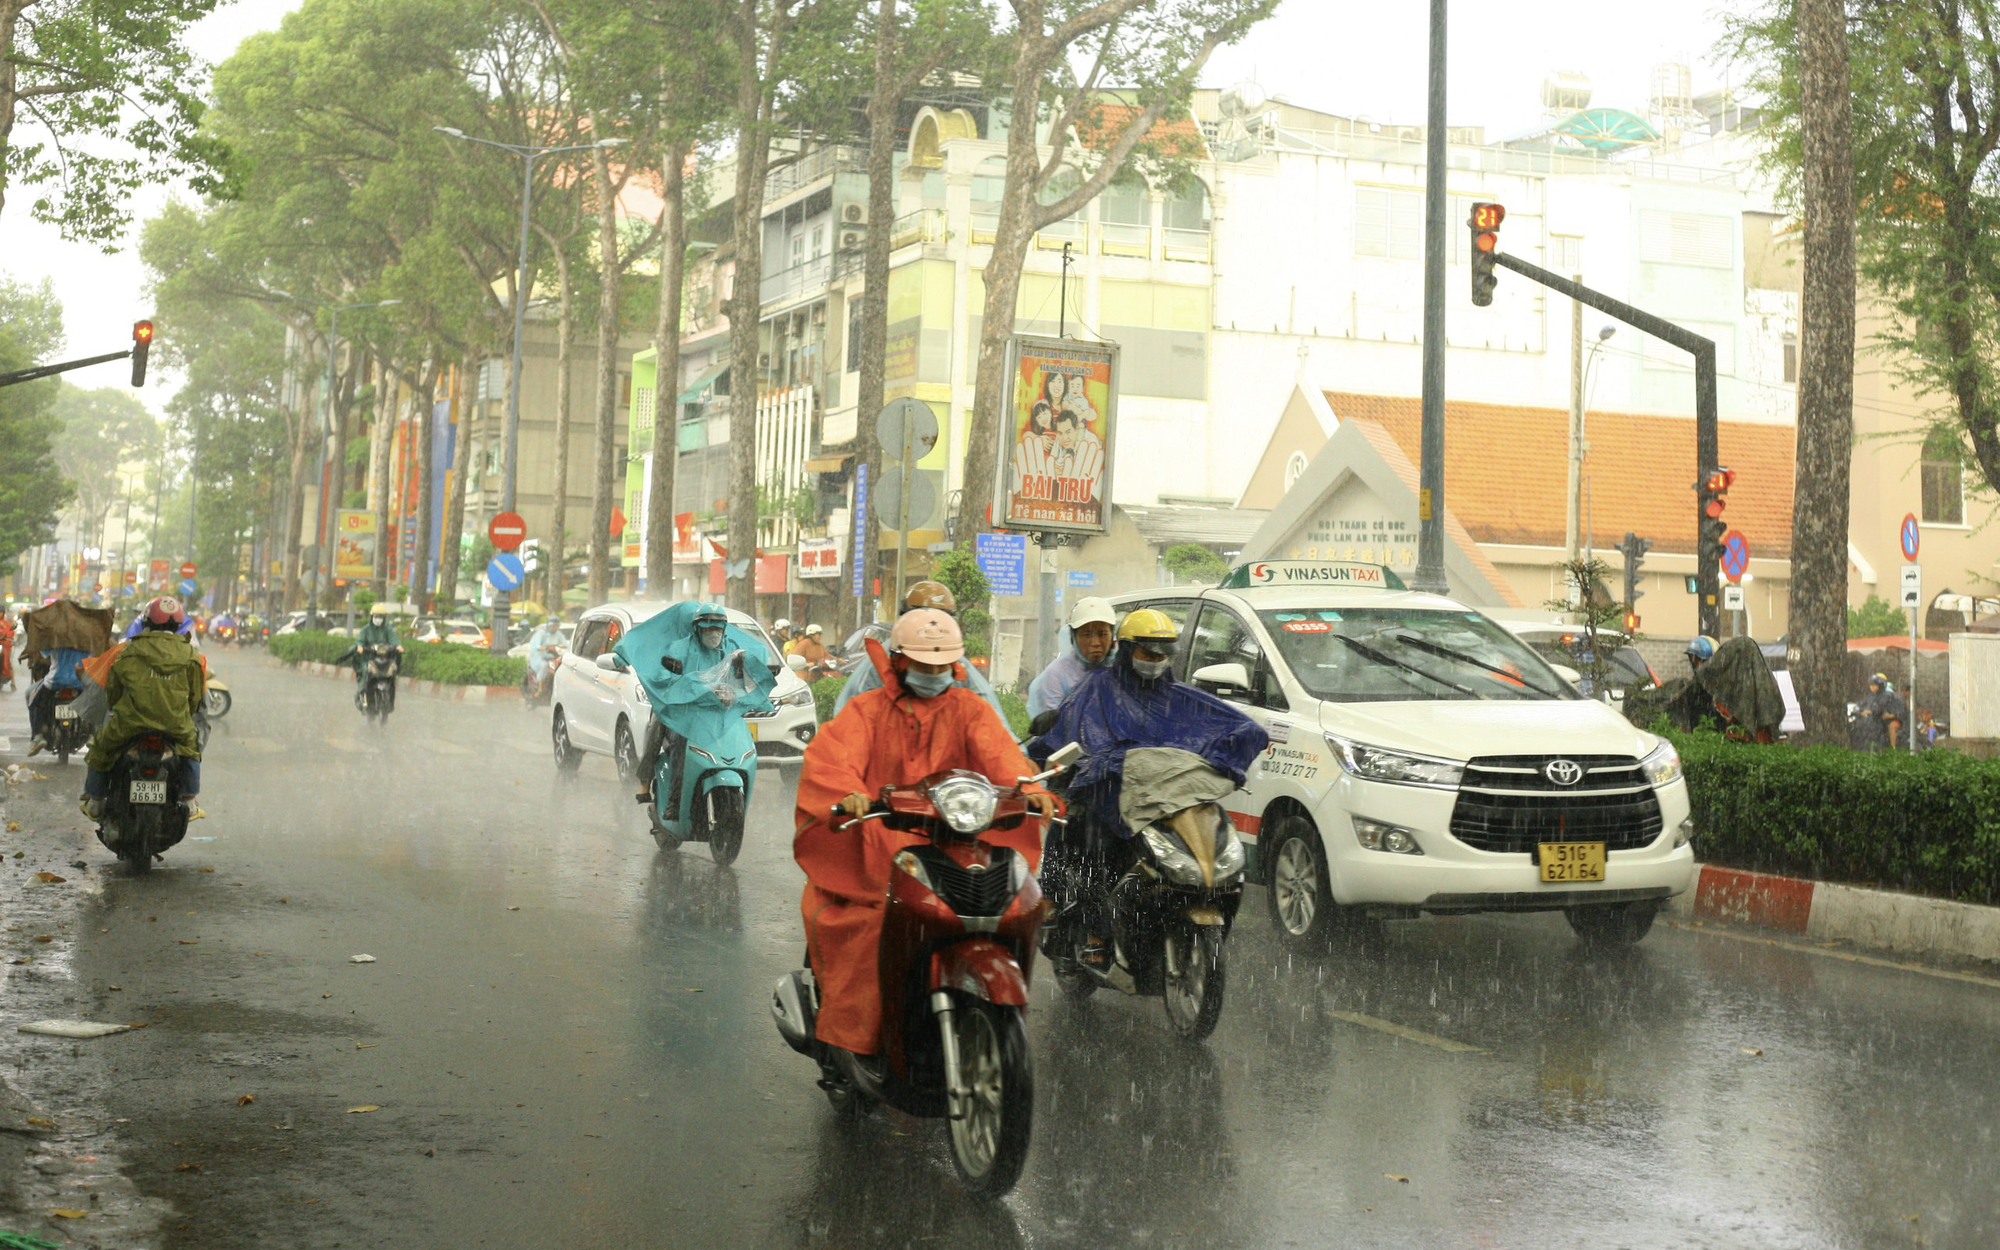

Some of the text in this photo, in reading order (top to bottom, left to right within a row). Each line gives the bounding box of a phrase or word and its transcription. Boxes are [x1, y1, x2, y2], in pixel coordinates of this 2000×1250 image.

[1478, 208, 1496, 227] 21
[1021, 470, 1094, 503] BÀI TRỪ
[1287, 622, 1328, 632] 10355
[1271, 761, 1281, 773] 38
[1282, 763, 1293, 774] 27
[1293, 765, 1305, 776] 27
[1305, 767, 1318, 778] 27
[1557, 845, 1587, 861] 51G
[1547, 863, 1598, 880] 621.64
